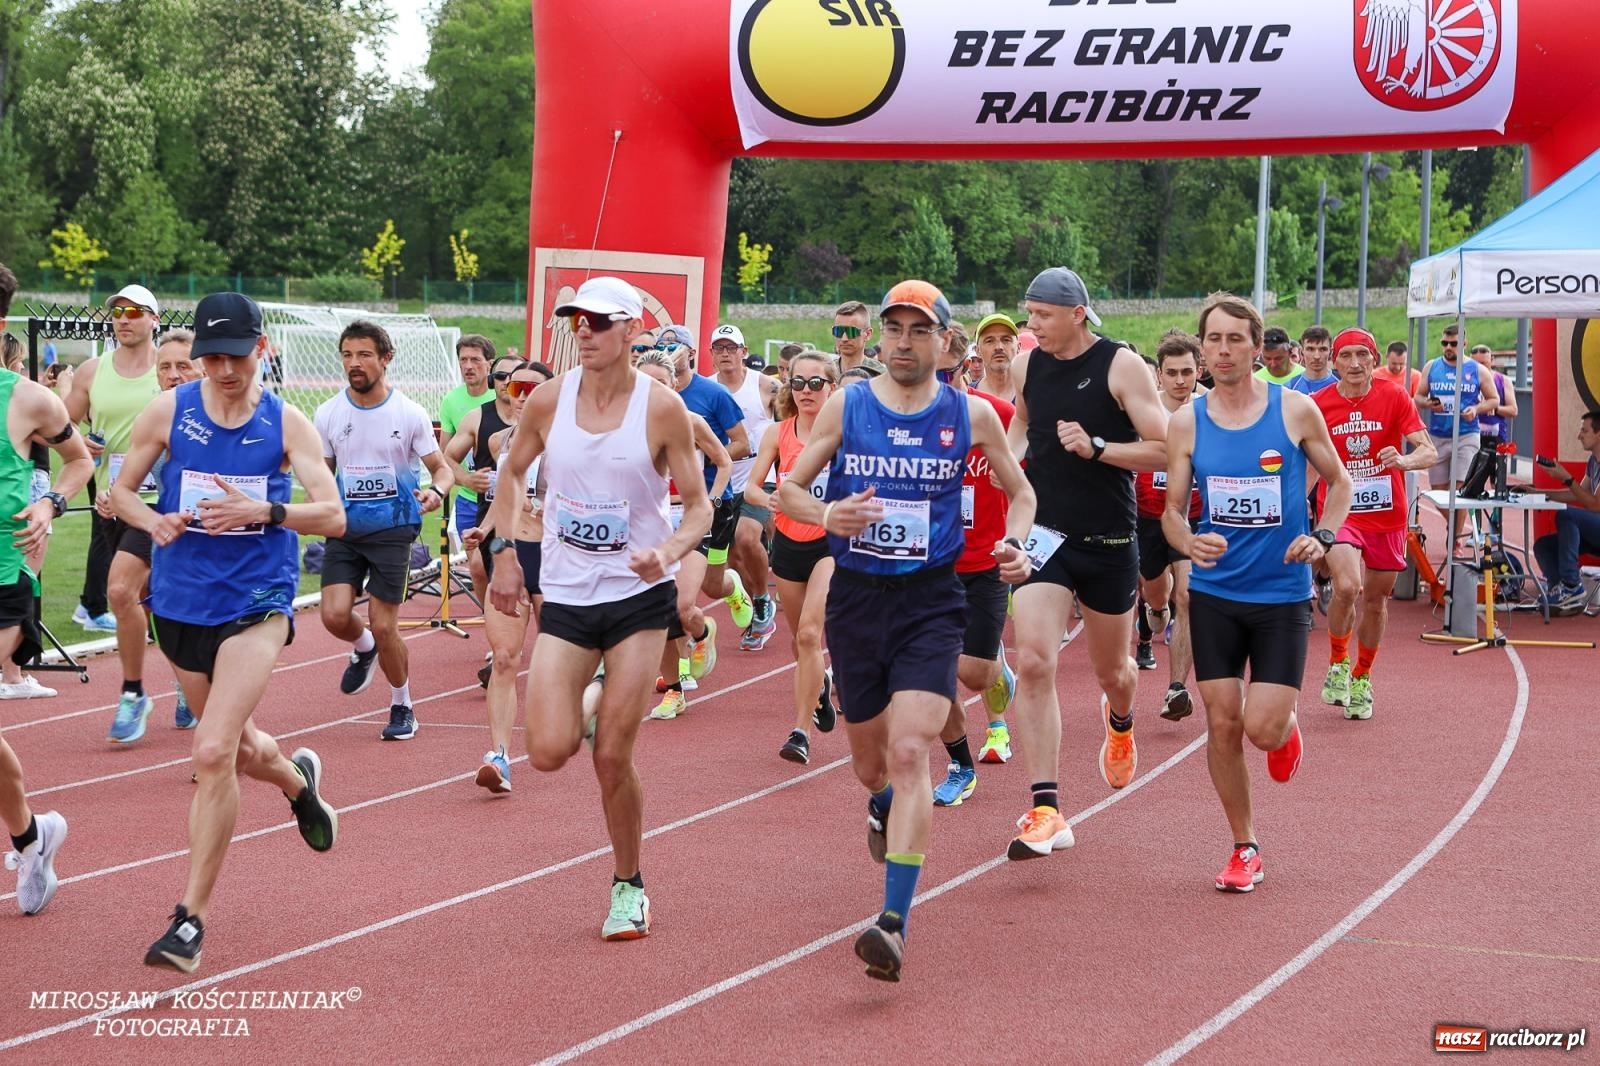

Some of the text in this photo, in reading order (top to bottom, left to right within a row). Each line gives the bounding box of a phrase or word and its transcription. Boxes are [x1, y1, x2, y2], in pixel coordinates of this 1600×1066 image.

[818, 0, 902, 26] SIR
[947, 24, 1291, 67] BEZ GRANIC
[975, 78, 1262, 124] RACIBÓRZ
[1496, 268, 1600, 295] Person
[1349, 411, 1362, 421] OD
[1331, 420, 1383, 435] URODZENIA
[844, 453, 962, 480] RUNNERS
[1346, 458, 1375, 469] DUMNI
[1348, 463, 1386, 479] CHODZENIA
[356, 479, 384, 491] 205
[1227, 497, 1261, 515] 251
[1354, 491, 1380, 504] 168
[571, 520, 610, 541] 220
[869, 522, 906, 543] 163
